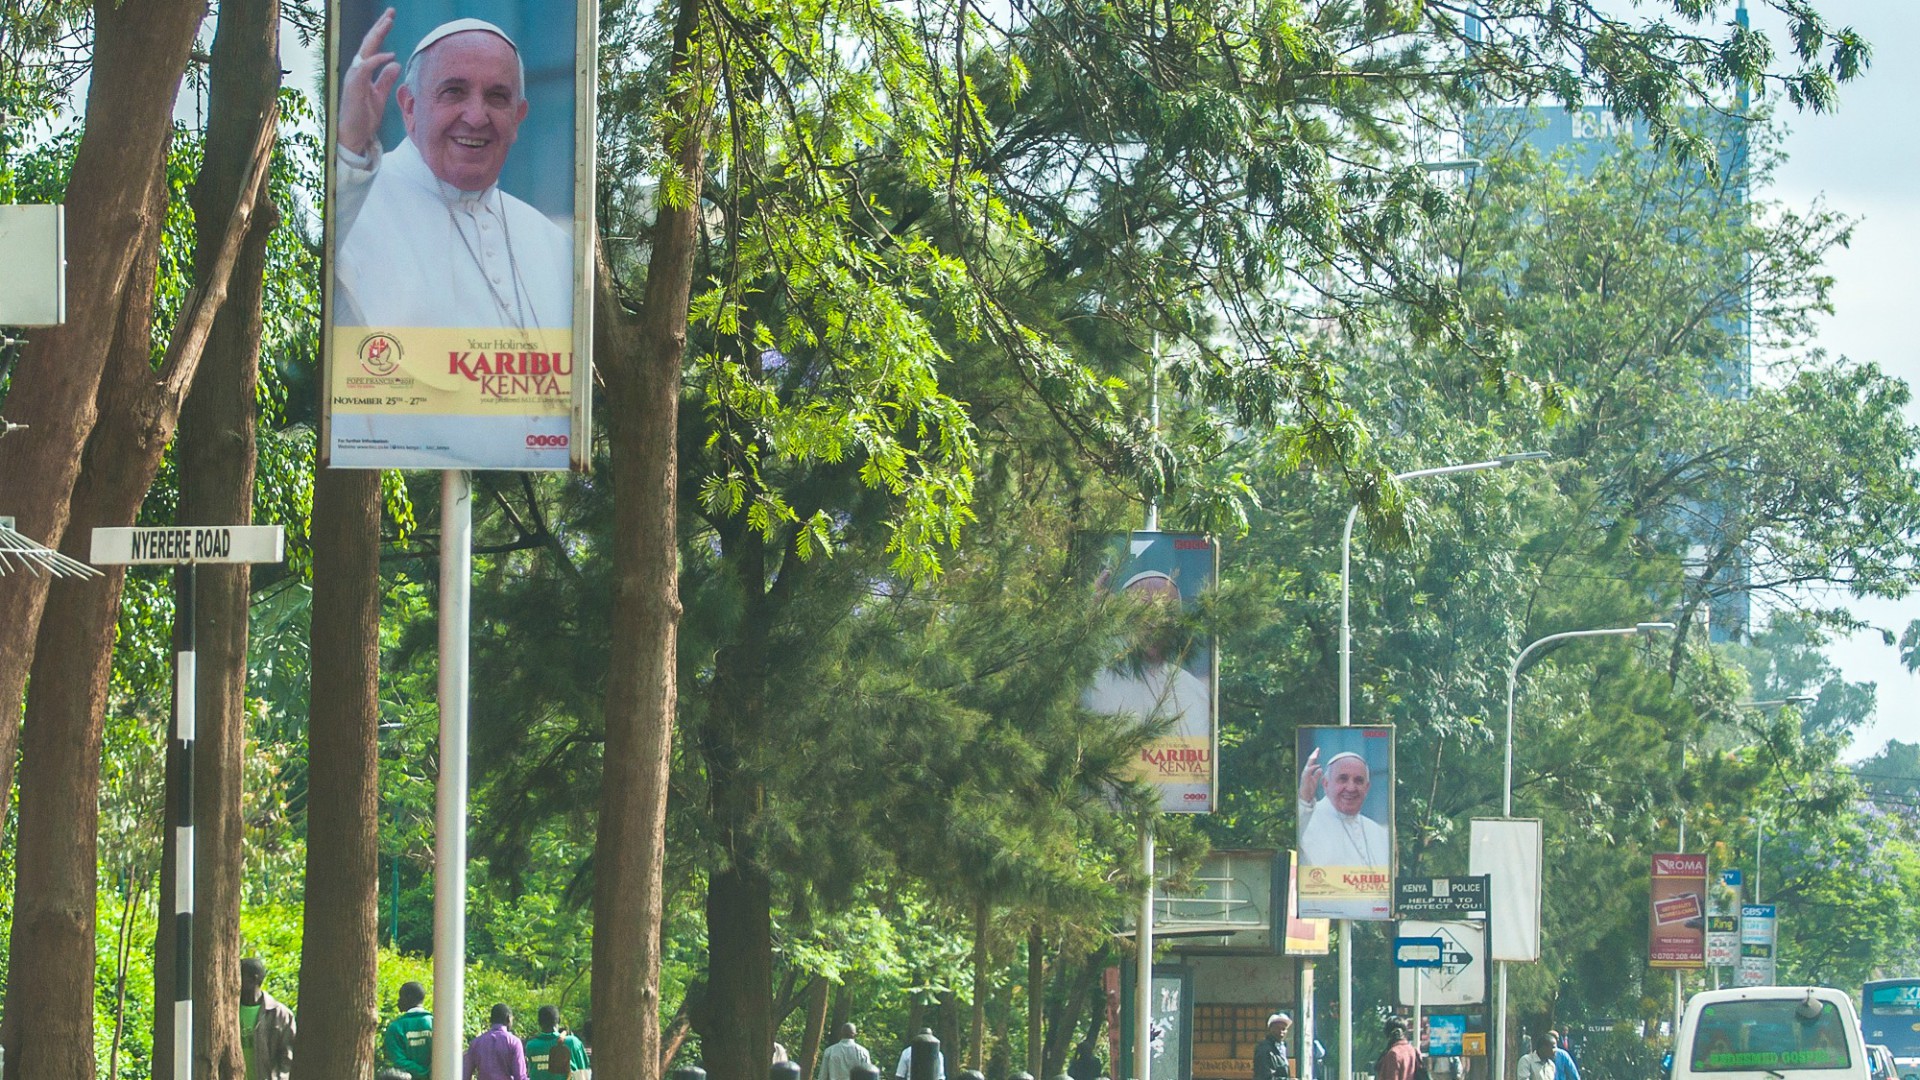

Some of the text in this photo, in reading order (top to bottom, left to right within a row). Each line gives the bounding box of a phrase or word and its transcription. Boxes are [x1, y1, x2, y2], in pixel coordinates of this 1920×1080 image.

[467, 339, 538, 349] Your Holiness
[448, 352, 573, 381] KARIBU
[131, 529, 231, 559] NYERERE ROAD
[1142, 748, 1210, 765] KARIBU
[1668, 860, 1703, 870] ROMA
[1343, 874, 1390, 885] KARIBU
[1402, 883, 1481, 893] KENYA POLICE
